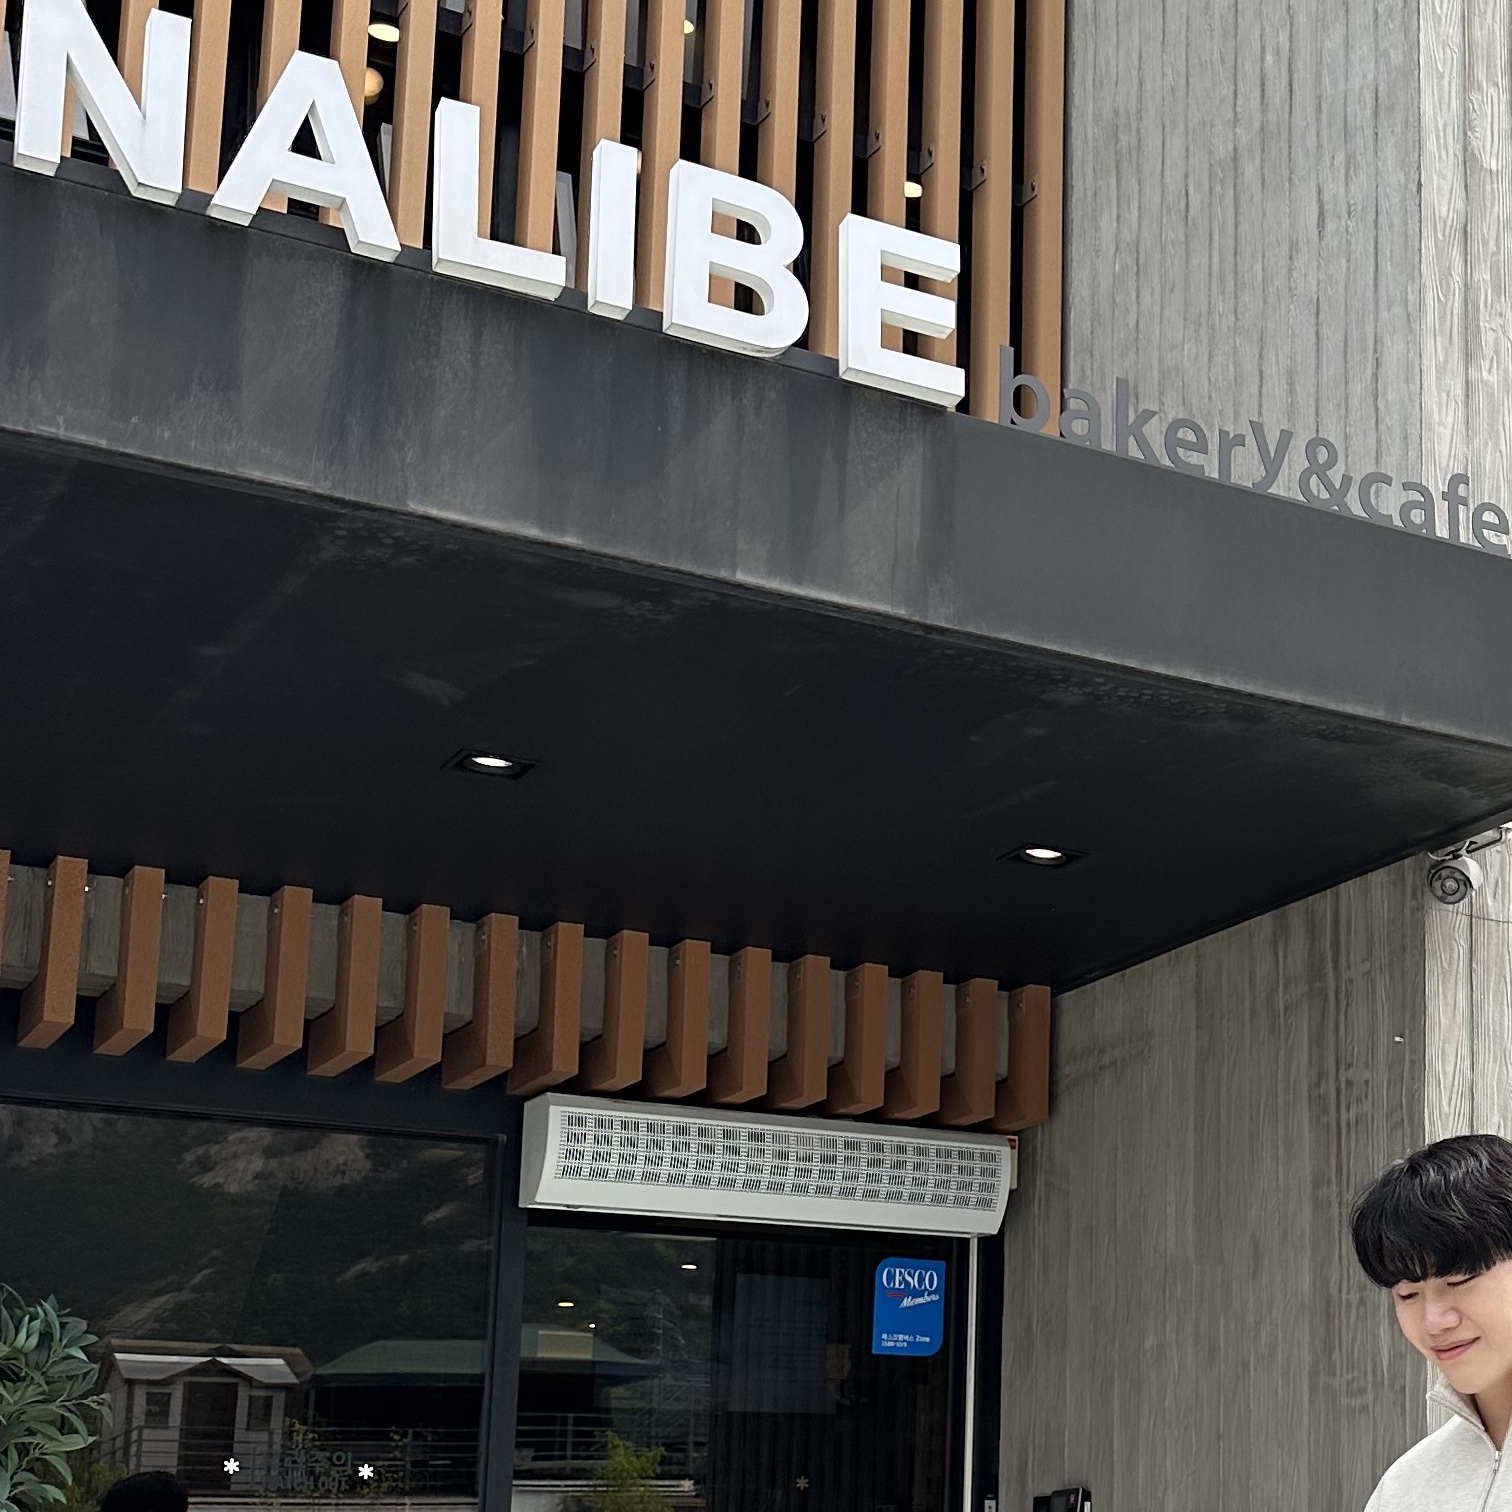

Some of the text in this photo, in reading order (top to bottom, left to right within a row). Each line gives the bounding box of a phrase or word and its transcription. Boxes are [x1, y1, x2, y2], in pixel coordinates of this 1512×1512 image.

[14, 0, 966, 409] NALIBE
[999, 344, 1510, 557] bakery&cafe
[882, 1266, 938, 1291] CESCO
[899, 1291, 940, 1309] Members
